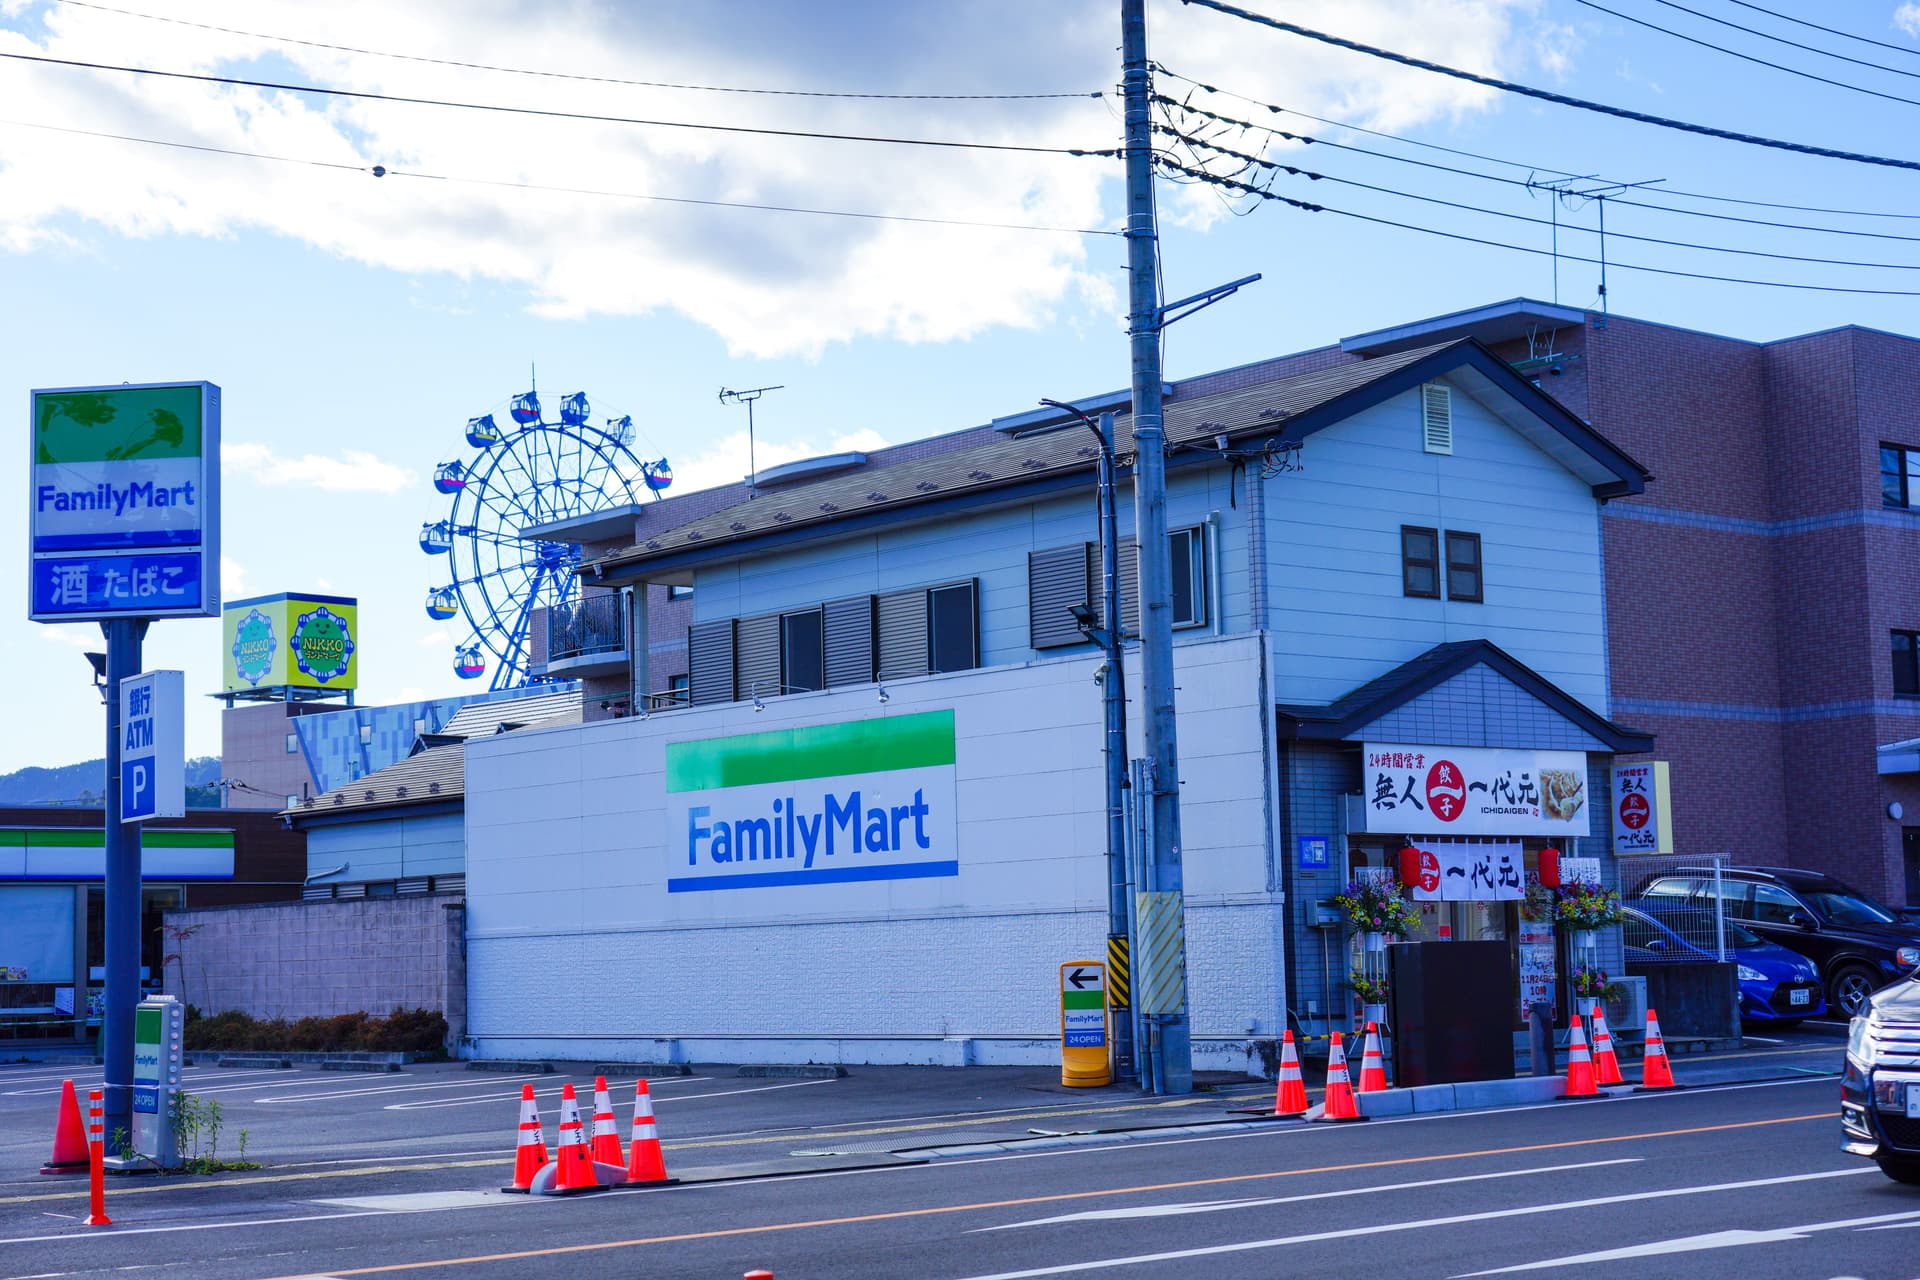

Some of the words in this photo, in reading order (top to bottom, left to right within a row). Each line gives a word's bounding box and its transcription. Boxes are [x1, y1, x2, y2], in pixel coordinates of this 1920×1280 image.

[38, 480, 195, 516] FamilyMart
[51, 565, 89, 605] 酒
[103, 566, 184, 598] たばこ
[240, 639, 269, 655] NIKKO
[302, 637, 344, 652] NIKKO
[129, 685, 151, 717] 銀行
[126, 717, 153, 750] ATM
[1369, 752, 1425, 769] 24時間営業
[133, 765, 146, 810] P
[1372, 772, 1424, 811] 無人
[1468, 770, 1539, 806] 一代元
[1480, 806, 1529, 815] ICHIDAIGEN
[687, 788, 930, 868] FamilyMart
[1446, 855, 1520, 889] 一代元
[1065, 1015, 1104, 1024] FamilyMart
